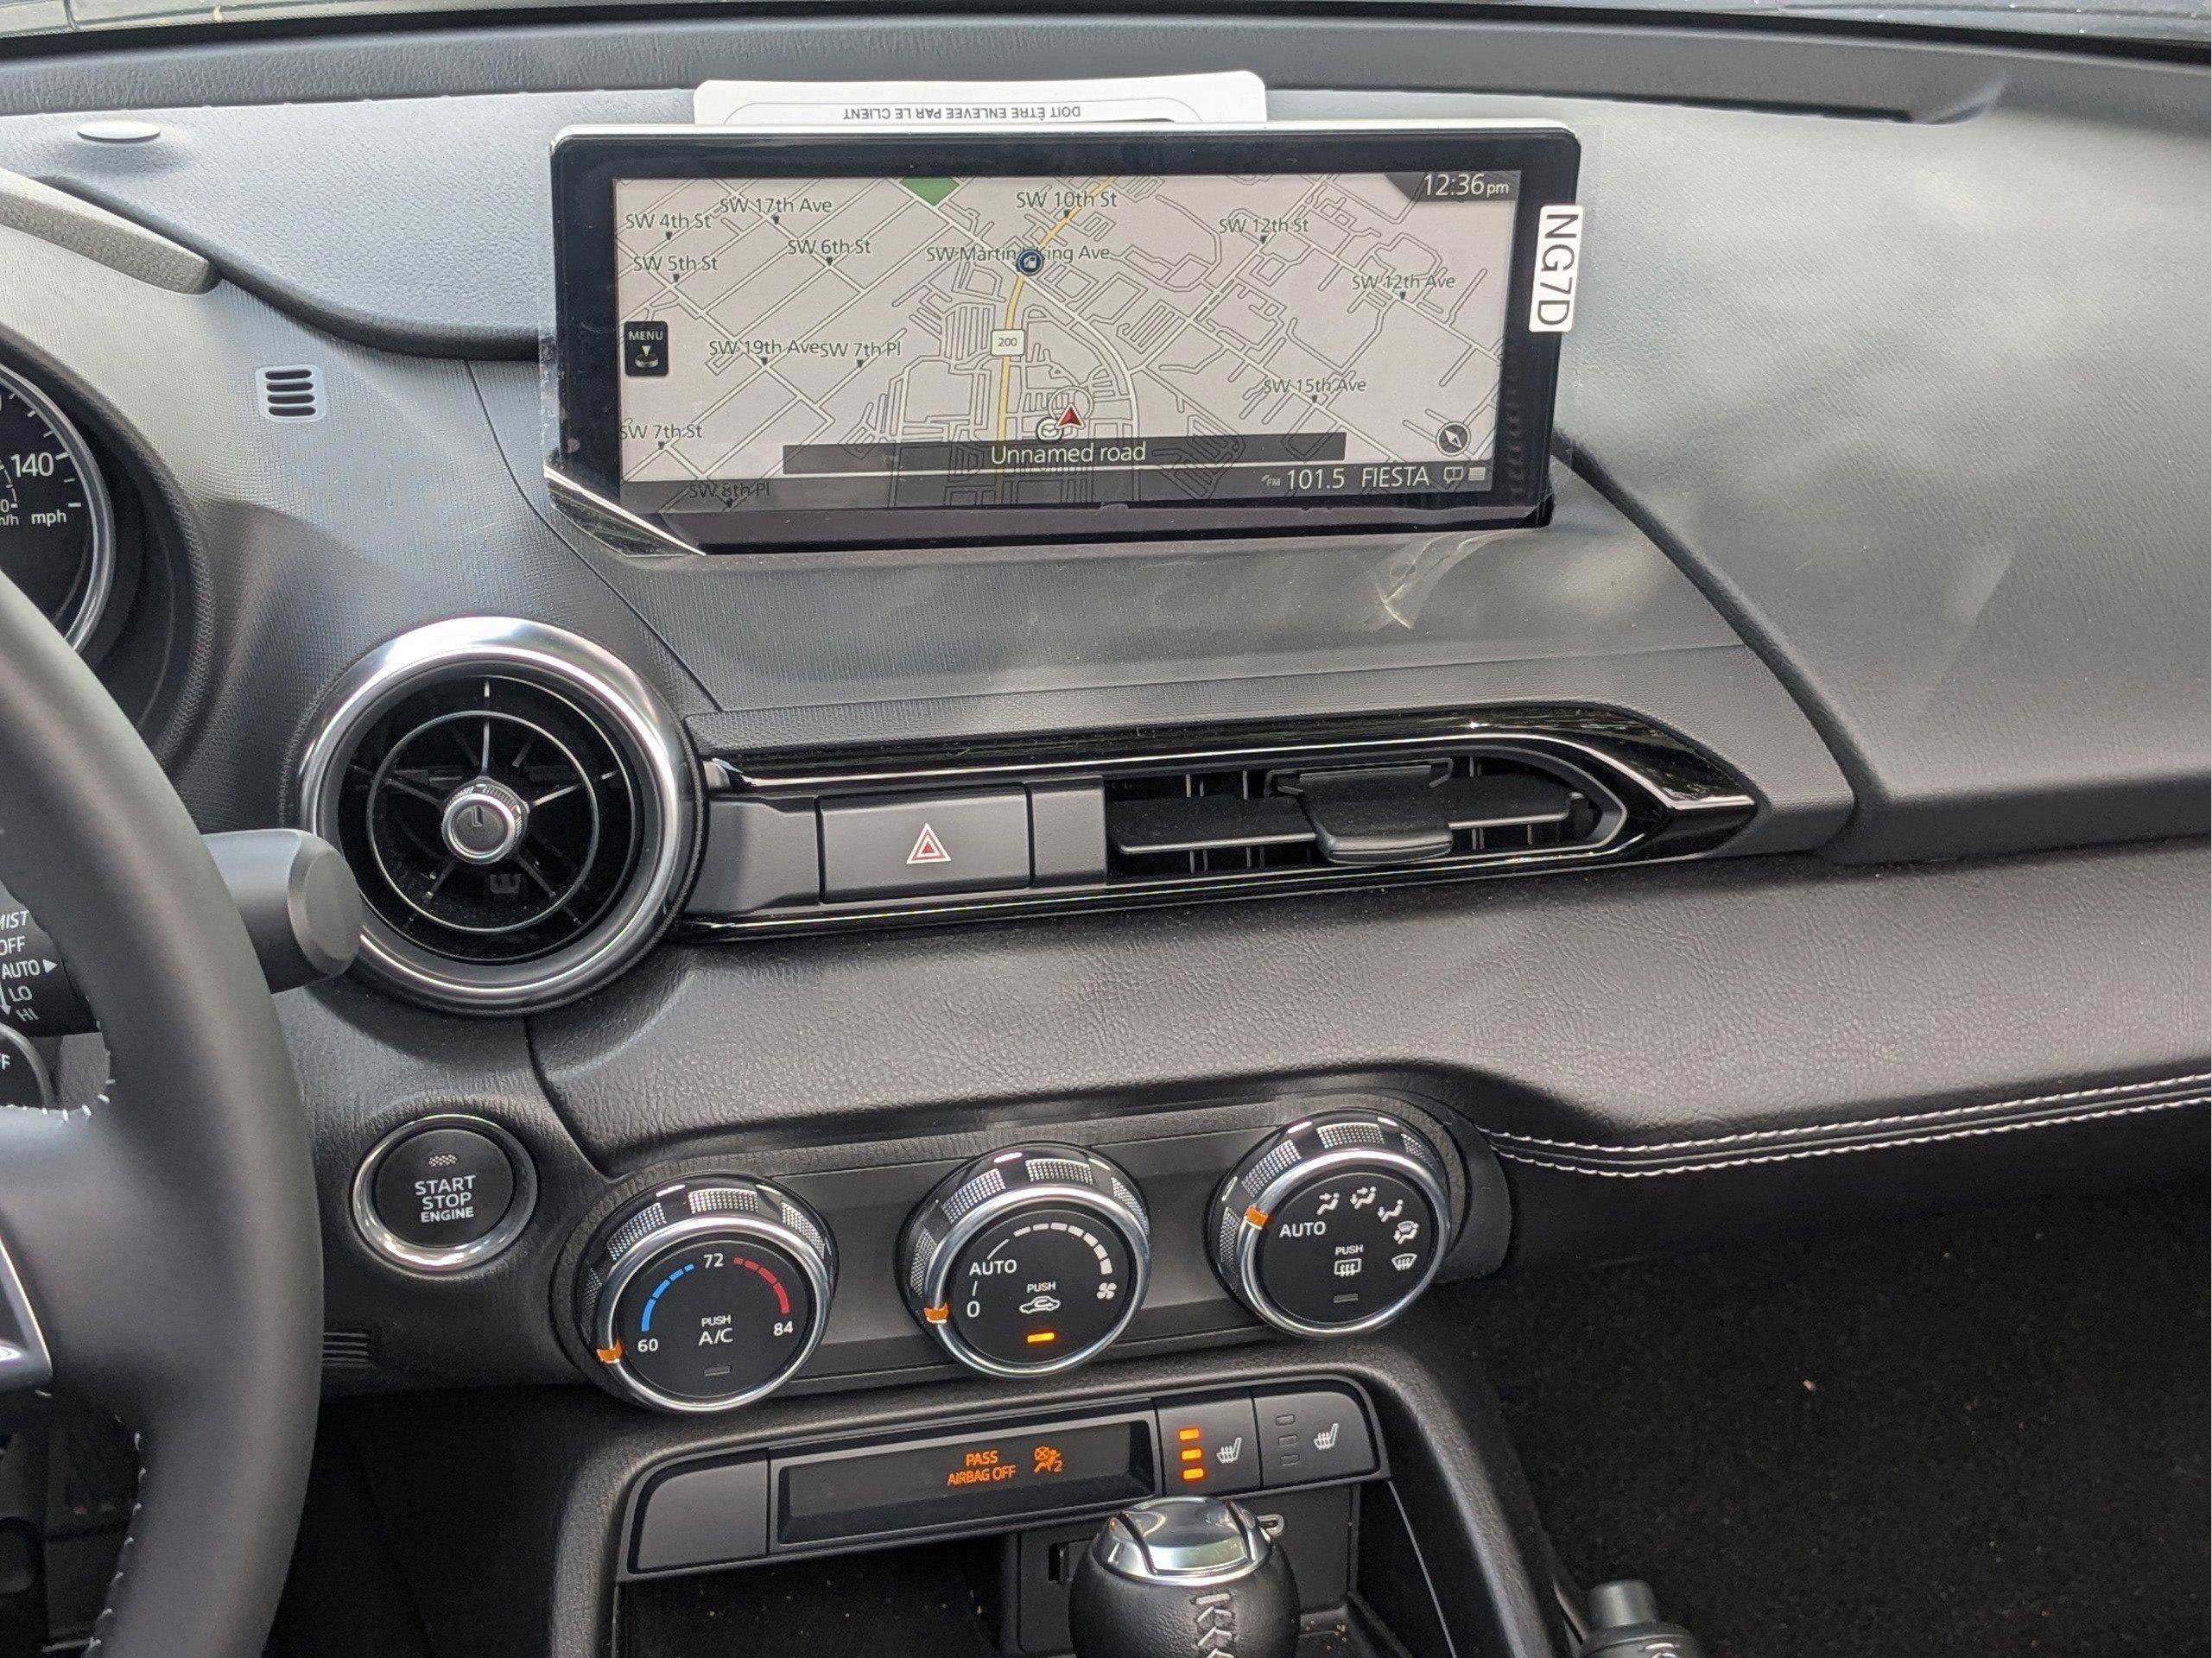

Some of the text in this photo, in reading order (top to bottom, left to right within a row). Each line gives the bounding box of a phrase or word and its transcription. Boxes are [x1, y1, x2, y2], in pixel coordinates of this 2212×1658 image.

[843, 105, 1081, 121] DOIT ÊTRE ENLEVEE PAR LE CLIENT
[1423, 174, 1509, 197] 12:36 pm
[720, 198, 832, 212] SW 17th Ave
[1017, 192, 1118, 206] SW 10th St
[625, 214, 710, 228] SW 4th St
[1219, 218, 1309, 233] SW 12th St
[788, 239, 871, 254] SW 6th St
[926, 247, 957, 262] SW
[960, 246, 1016, 261] Martin
[1079, 246, 1109, 260] Ave
[633, 256, 718, 270] SW 5th St
[1537, 214, 1579, 326] NG7D
[1352, 275, 1455, 289] SW 12th Ave
[628, 332, 663, 341] MENU
[998, 337, 1017, 347] 200
[709, 340, 819, 355] SW 19th Ave
[820, 343, 851, 357] SW
[855, 342, 881, 357] 7th
[1264, 378, 1366, 392] SW 15th Ave
[620, 424, 702, 439] SW 7th St
[992, 440, 1146, 465] Unnamed road
[10, 452, 54, 478] 140
[1287, 468, 1345, 490] 101.5
[1361, 466, 1429, 488] FIESTA
[689, 484, 716, 498] SW
[721, 483, 749, 497] 8th
[31, 509, 67, 527] mph
[2, 959, 40, 979] AUTO
[9, 984, 33, 1002] LO
[16, 1006, 39, 1022] HI
[415, 1175, 476, 1195] START
[421, 1193, 472, 1209] STOP
[421, 1206, 474, 1224] ENGINE
[1279, 1220, 1327, 1238] AUTO
[1334, 1244, 1364, 1256] PUSH
[703, 1253, 724, 1269] 72
[969, 1259, 1017, 1276] AUTO
[1026, 1281, 1055, 1293] PUSH
[966, 1301, 980, 1318] 0
[700, 1315, 732, 1326] PUSH
[773, 1320, 793, 1337] 84
[699, 1326, 733, 1346] A/C
[637, 1338, 658, 1354] 60
[967, 1451, 998, 1466] PASS
[948, 1464, 1016, 1485] AIRBAG OFF
